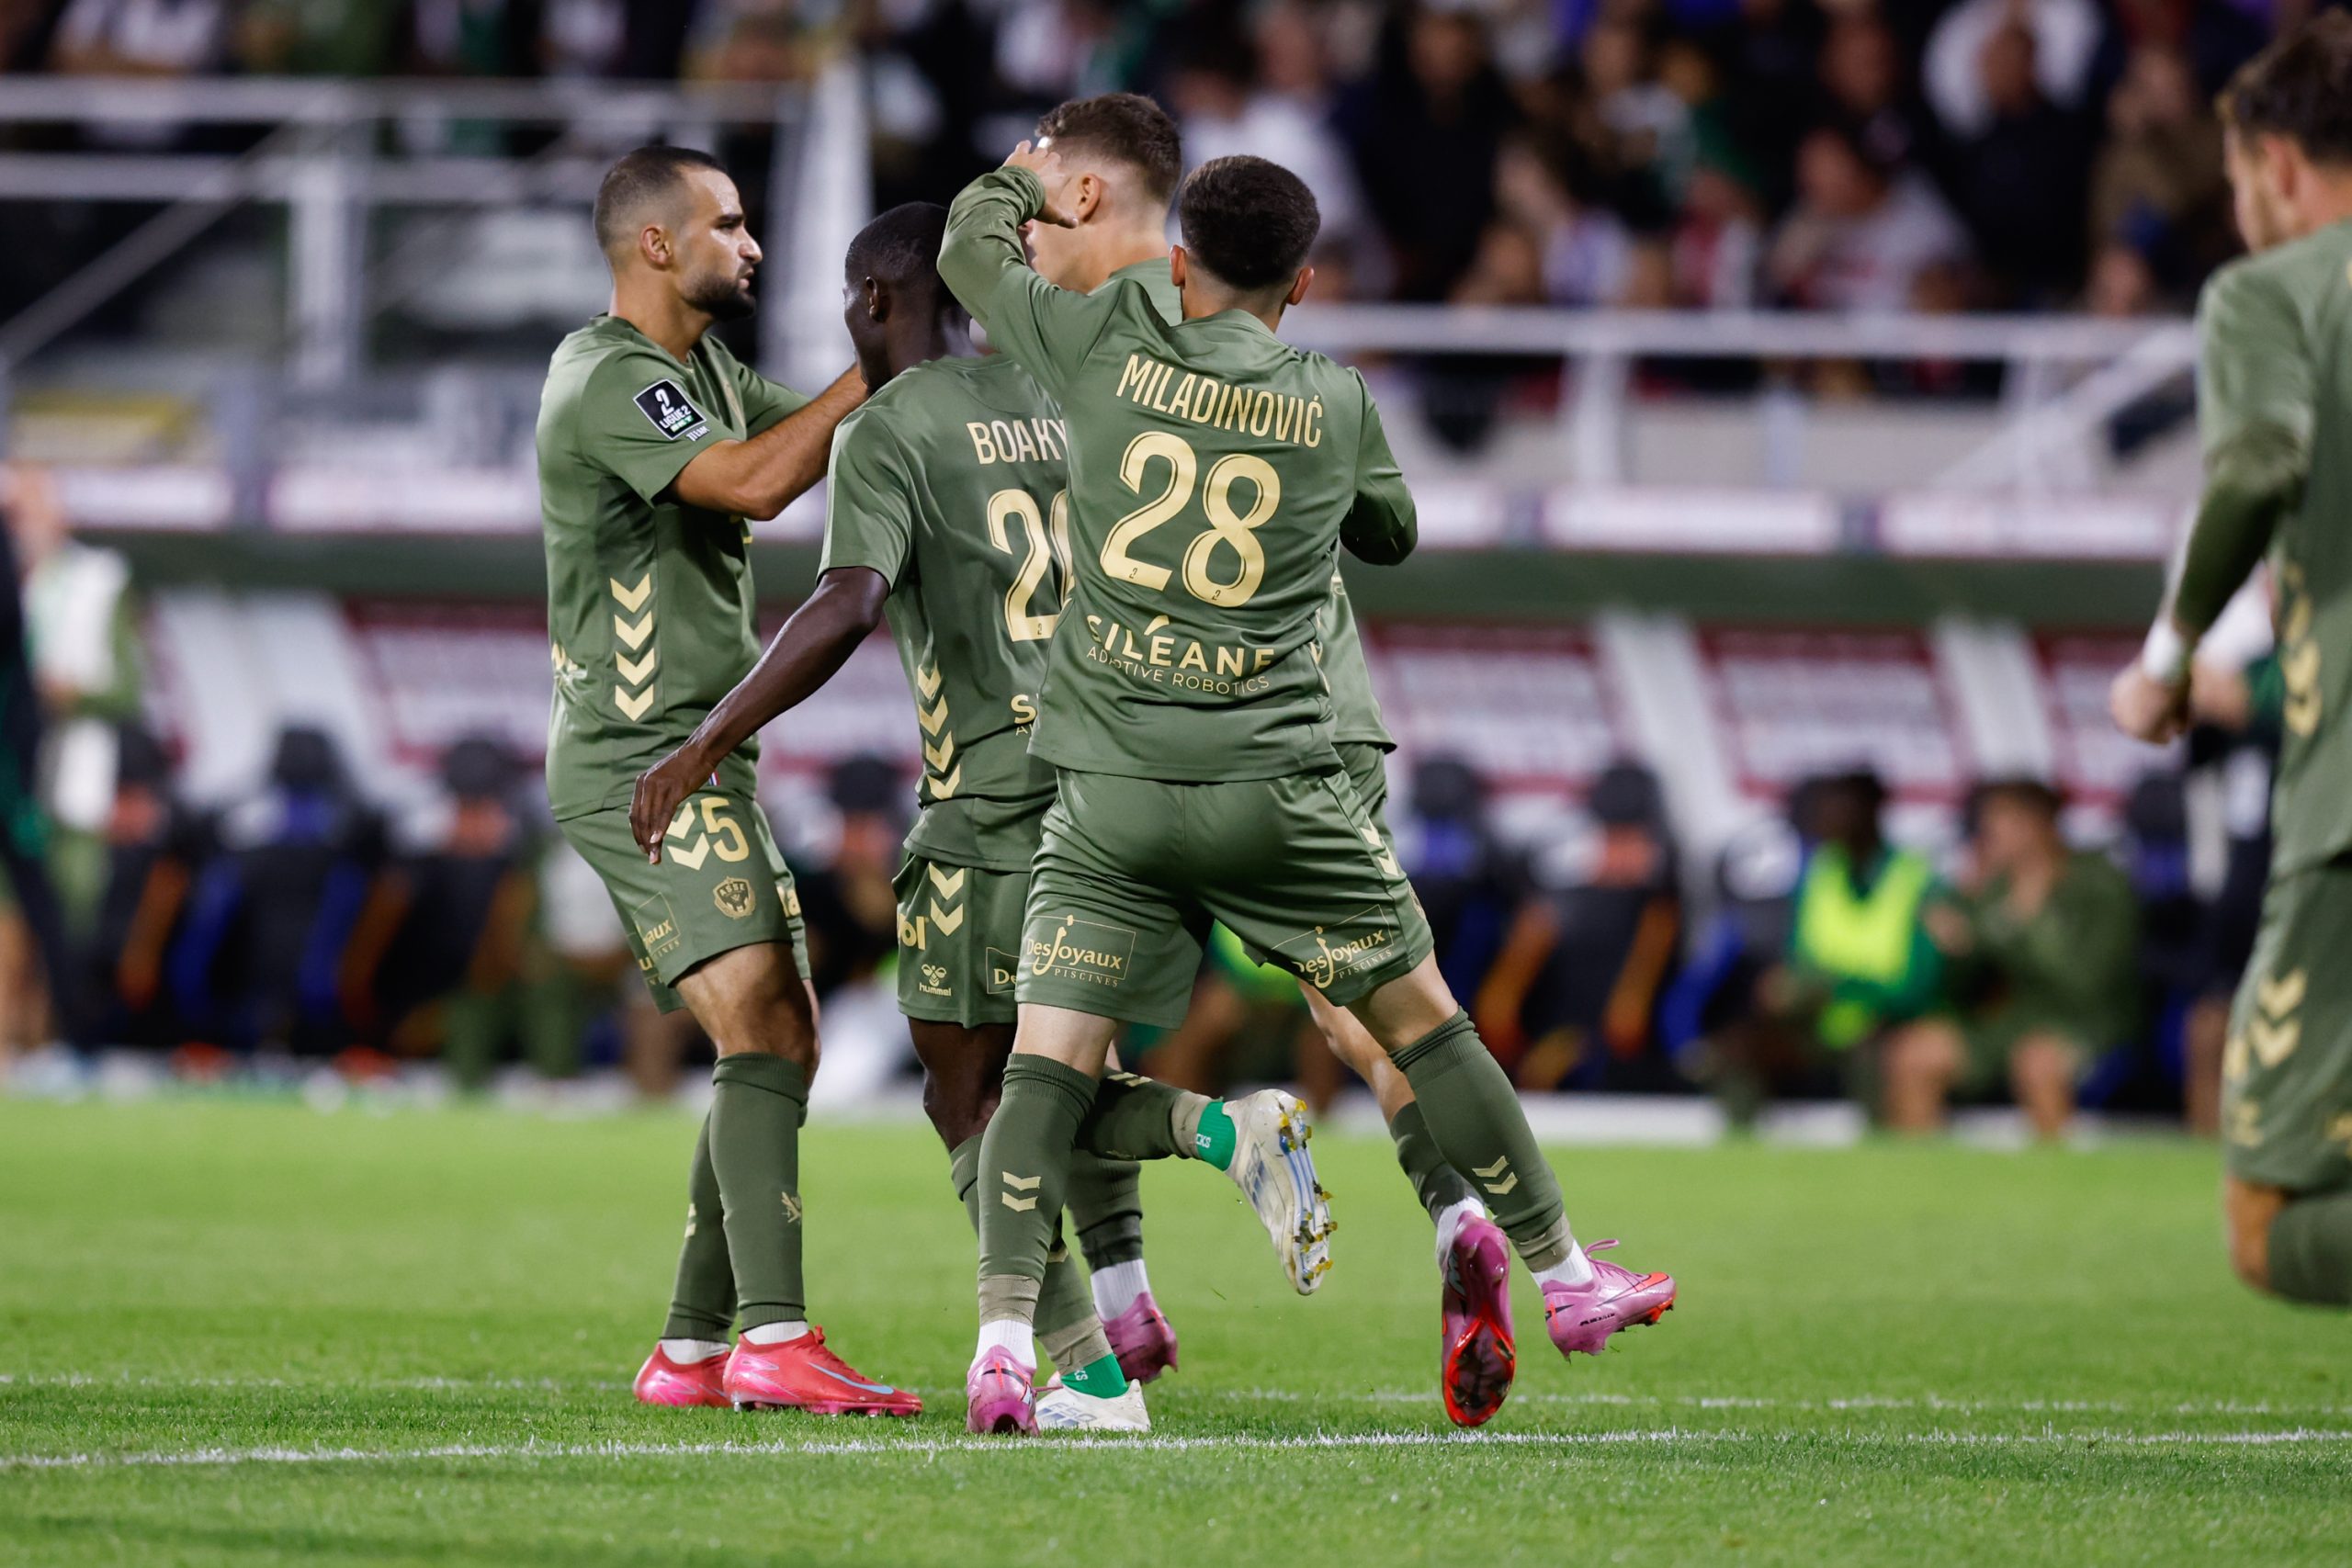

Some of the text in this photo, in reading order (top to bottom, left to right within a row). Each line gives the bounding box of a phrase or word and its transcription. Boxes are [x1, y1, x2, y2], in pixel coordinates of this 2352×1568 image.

[1115, 354, 1324, 448] MILADINOVIĆ
[1100, 431, 1281, 607] 28
[1172, 672, 1270, 695] ROBOTICS
[700, 797, 750, 862] 5
[719, 883, 745, 897] ASSE
[1055, 967, 1119, 988] PISCINES
[1339, 950, 1393, 979] PISCINES
[919, 982, 952, 997] hummel
